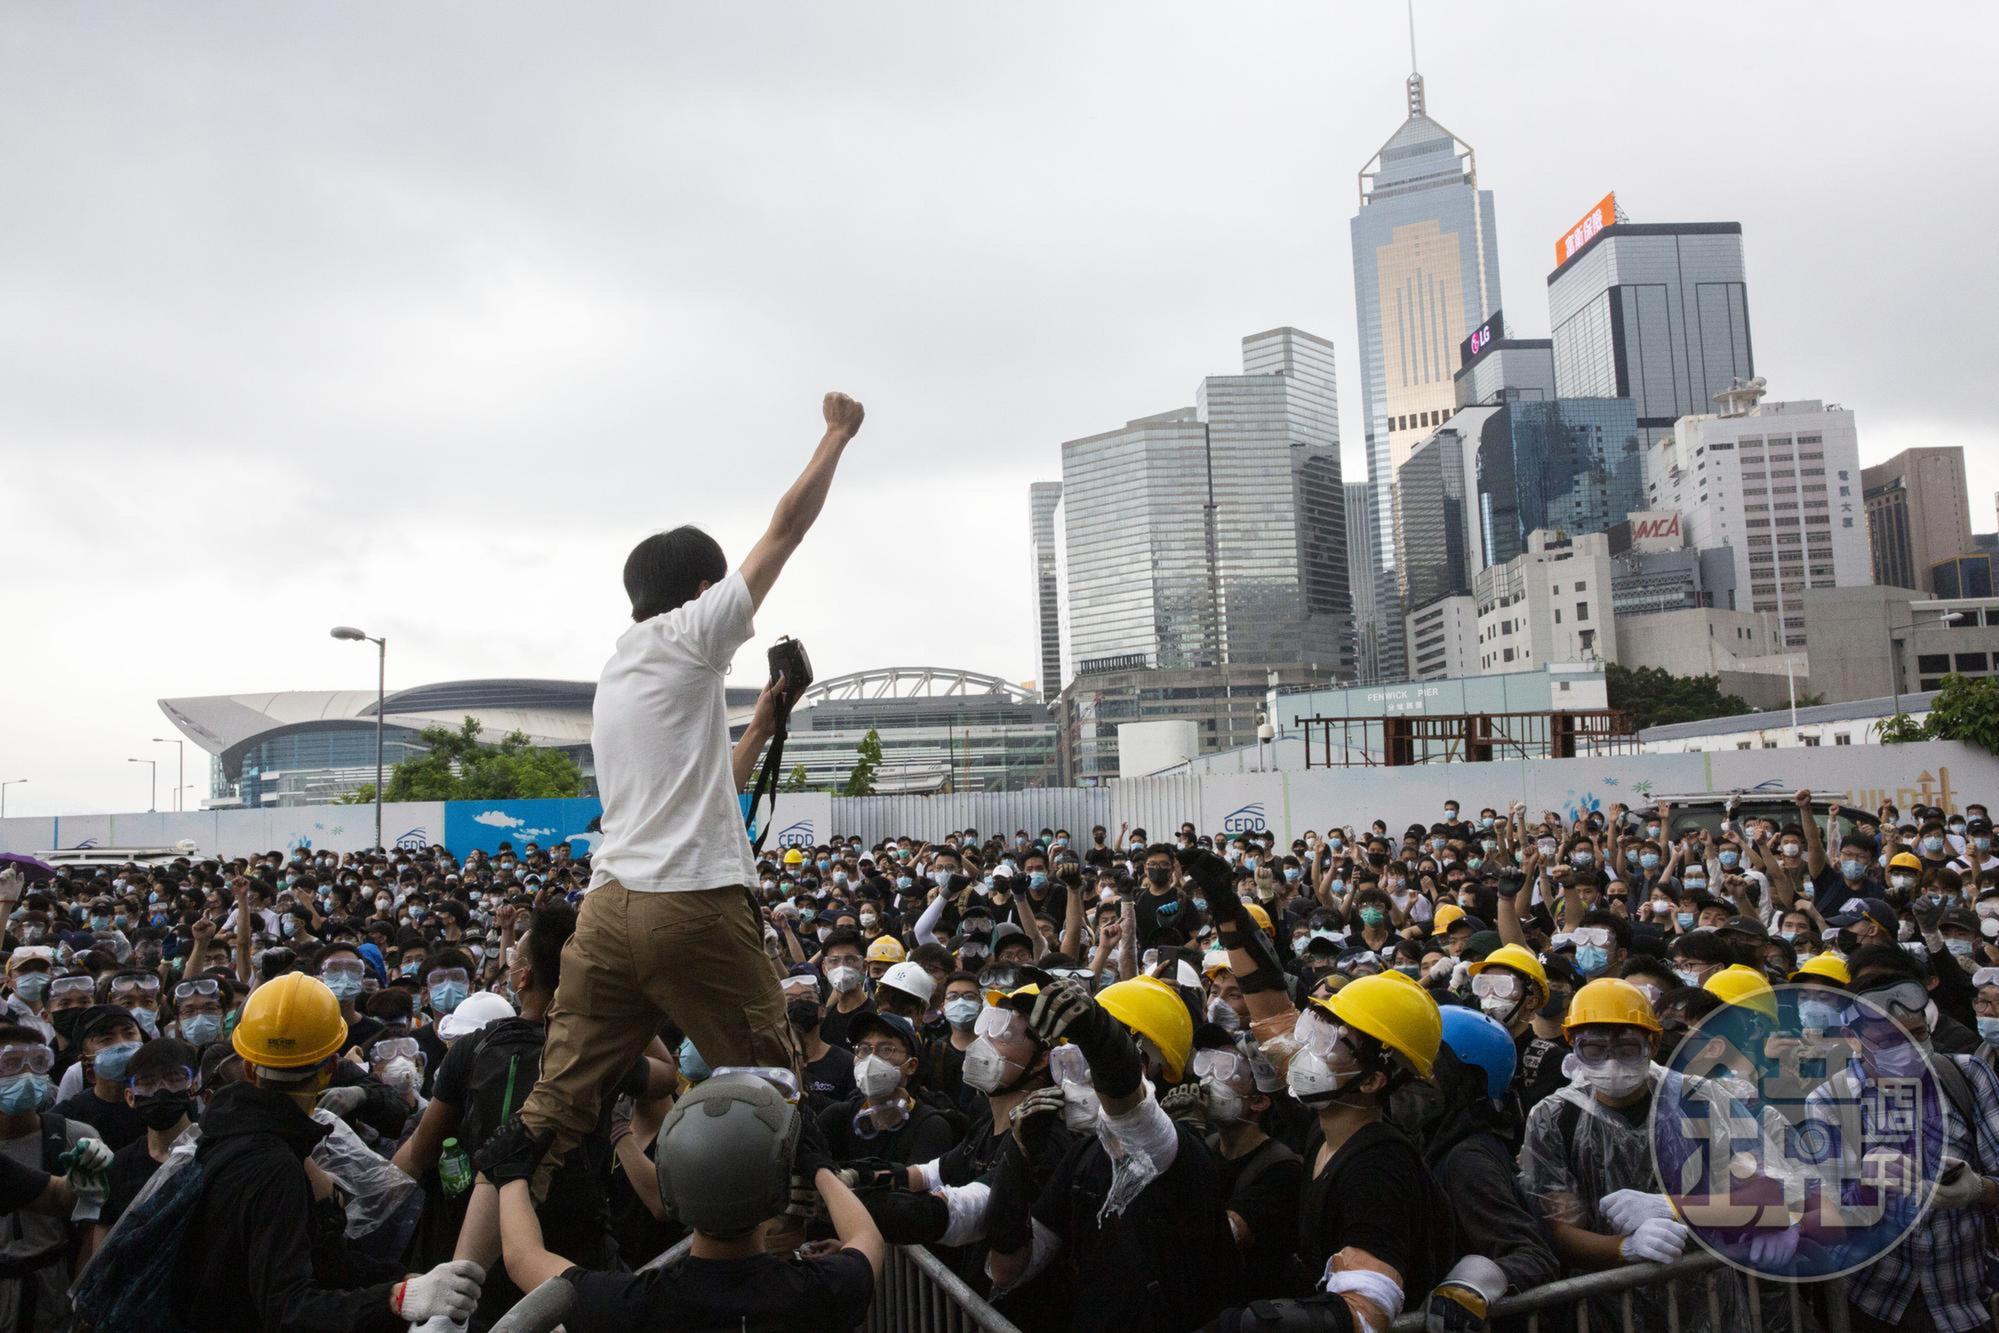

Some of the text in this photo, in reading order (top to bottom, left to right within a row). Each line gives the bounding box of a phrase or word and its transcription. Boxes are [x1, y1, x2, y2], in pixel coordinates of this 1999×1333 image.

[1479, 325, 1491, 347] LG
[1632, 512, 1679, 542] YMCA
[1367, 687, 1439, 702] FENWICK PIER
[1224, 818, 1266, 833] CEDD
[396, 840, 427, 854] CEDD
[778, 832, 814, 848] CEDD
